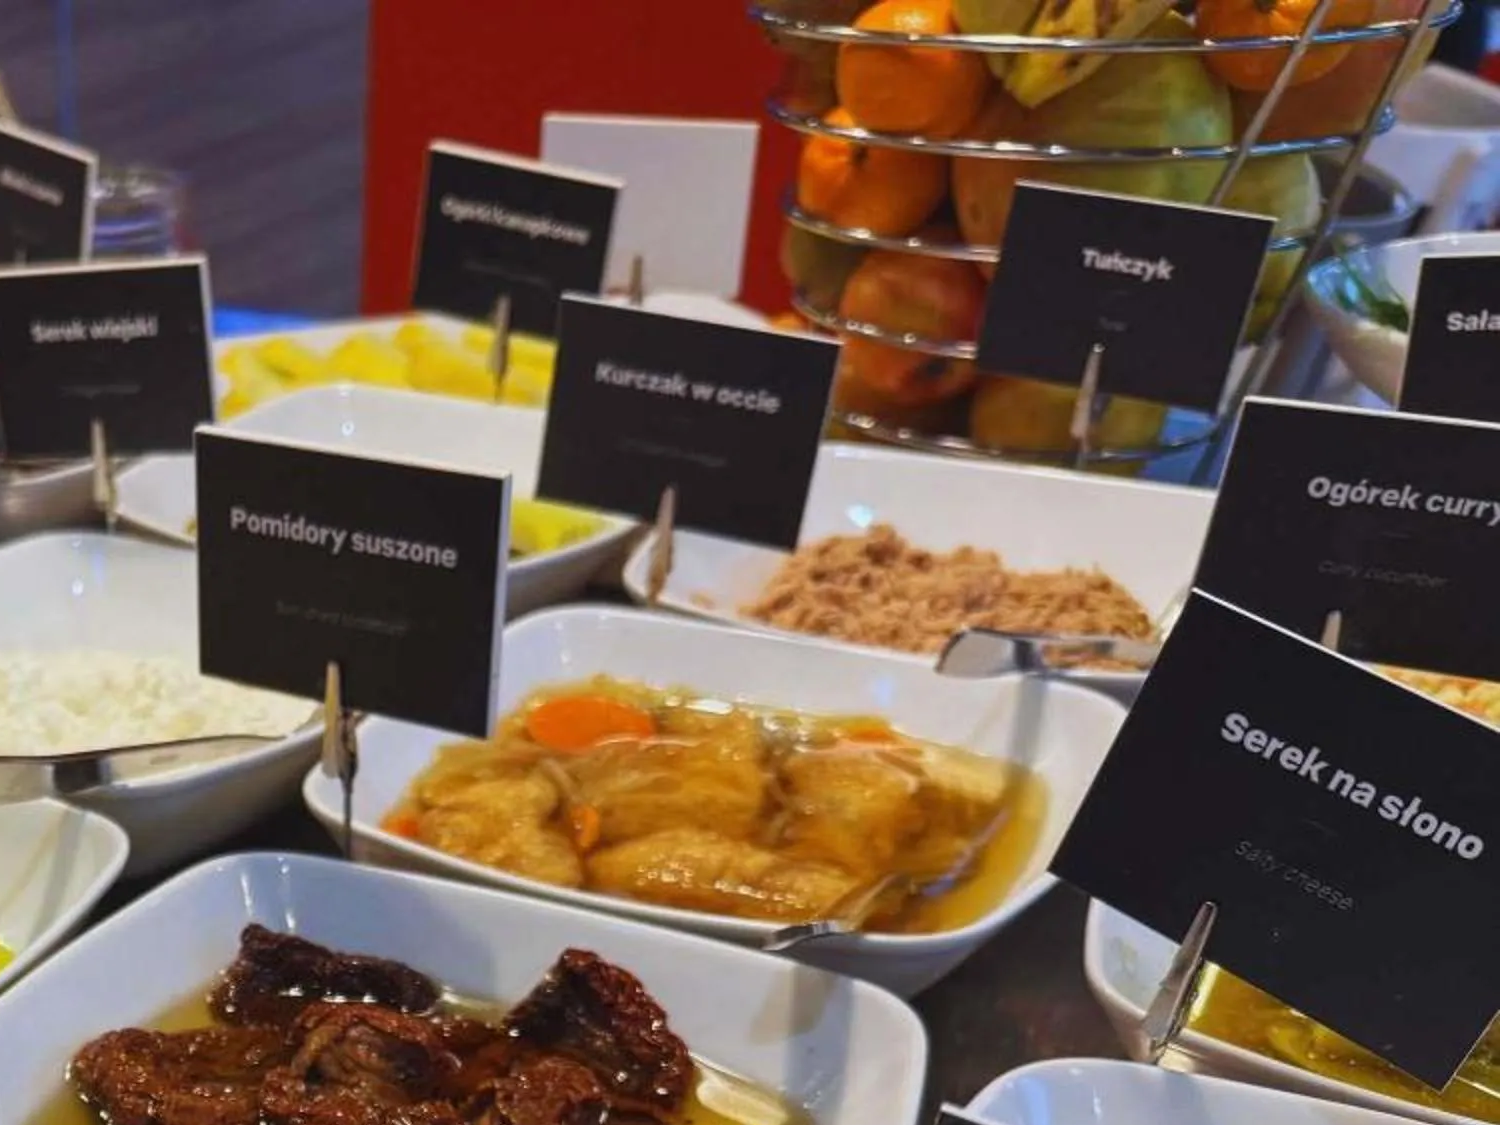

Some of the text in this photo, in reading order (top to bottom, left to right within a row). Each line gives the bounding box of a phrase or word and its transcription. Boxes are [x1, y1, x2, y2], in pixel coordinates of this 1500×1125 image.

[1082, 247, 1174, 282] Tuńczyk
[595, 361, 781, 414] Kurczak w occie
[1308, 476, 1500, 527] Ogórek curry
[230, 506, 458, 568] Pomidory suszone
[1220, 711, 1485, 861] Serek na słono
